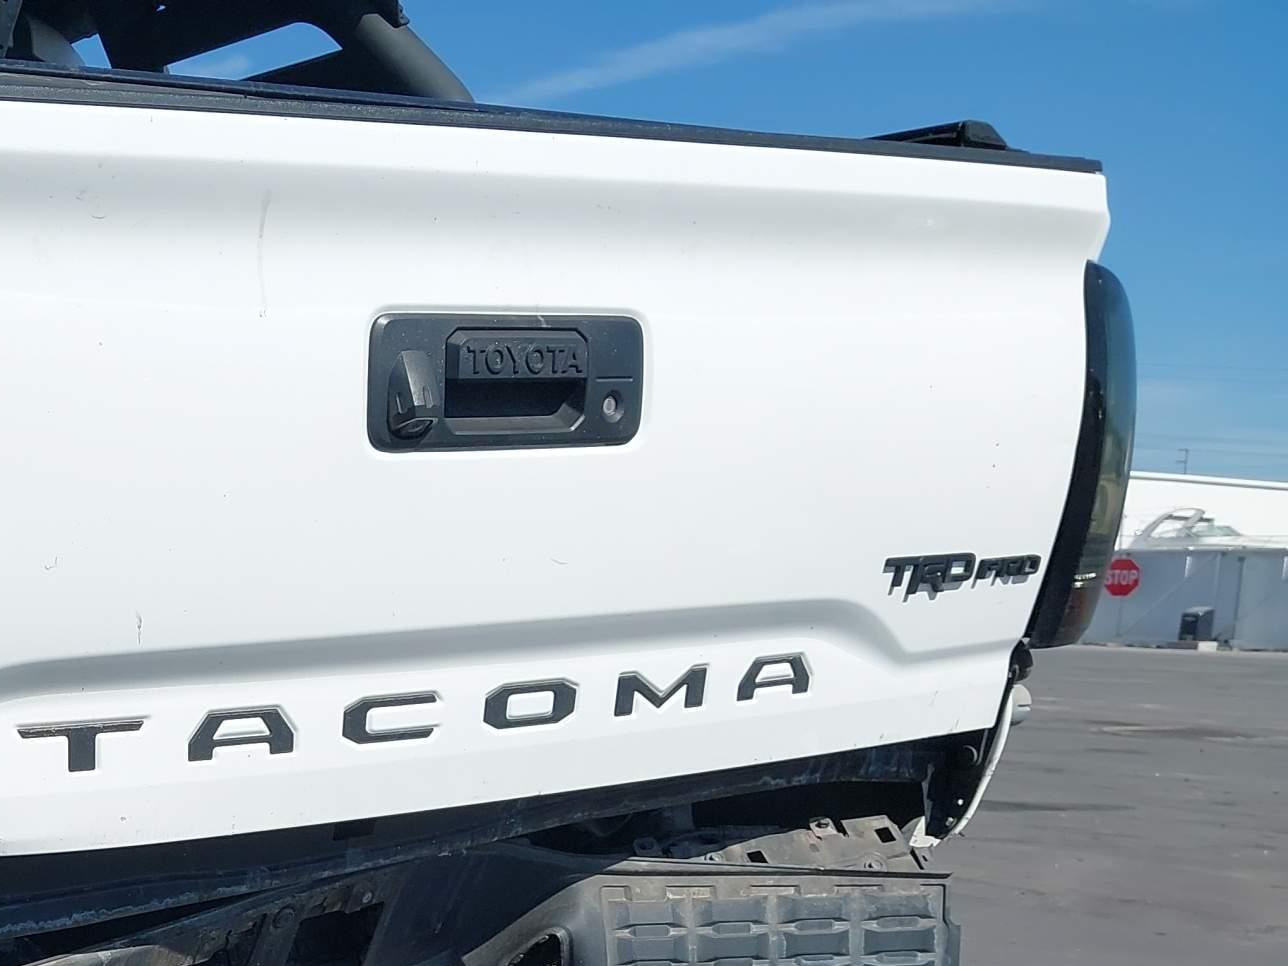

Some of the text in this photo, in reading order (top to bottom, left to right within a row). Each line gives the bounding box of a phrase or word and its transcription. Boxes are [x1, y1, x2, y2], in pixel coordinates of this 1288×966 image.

[466, 345, 583, 375] TOYOTA
[882, 552, 976, 595] TRD
[1105, 569, 1139, 585] STOP
[15, 652, 812, 773] TACOMA
